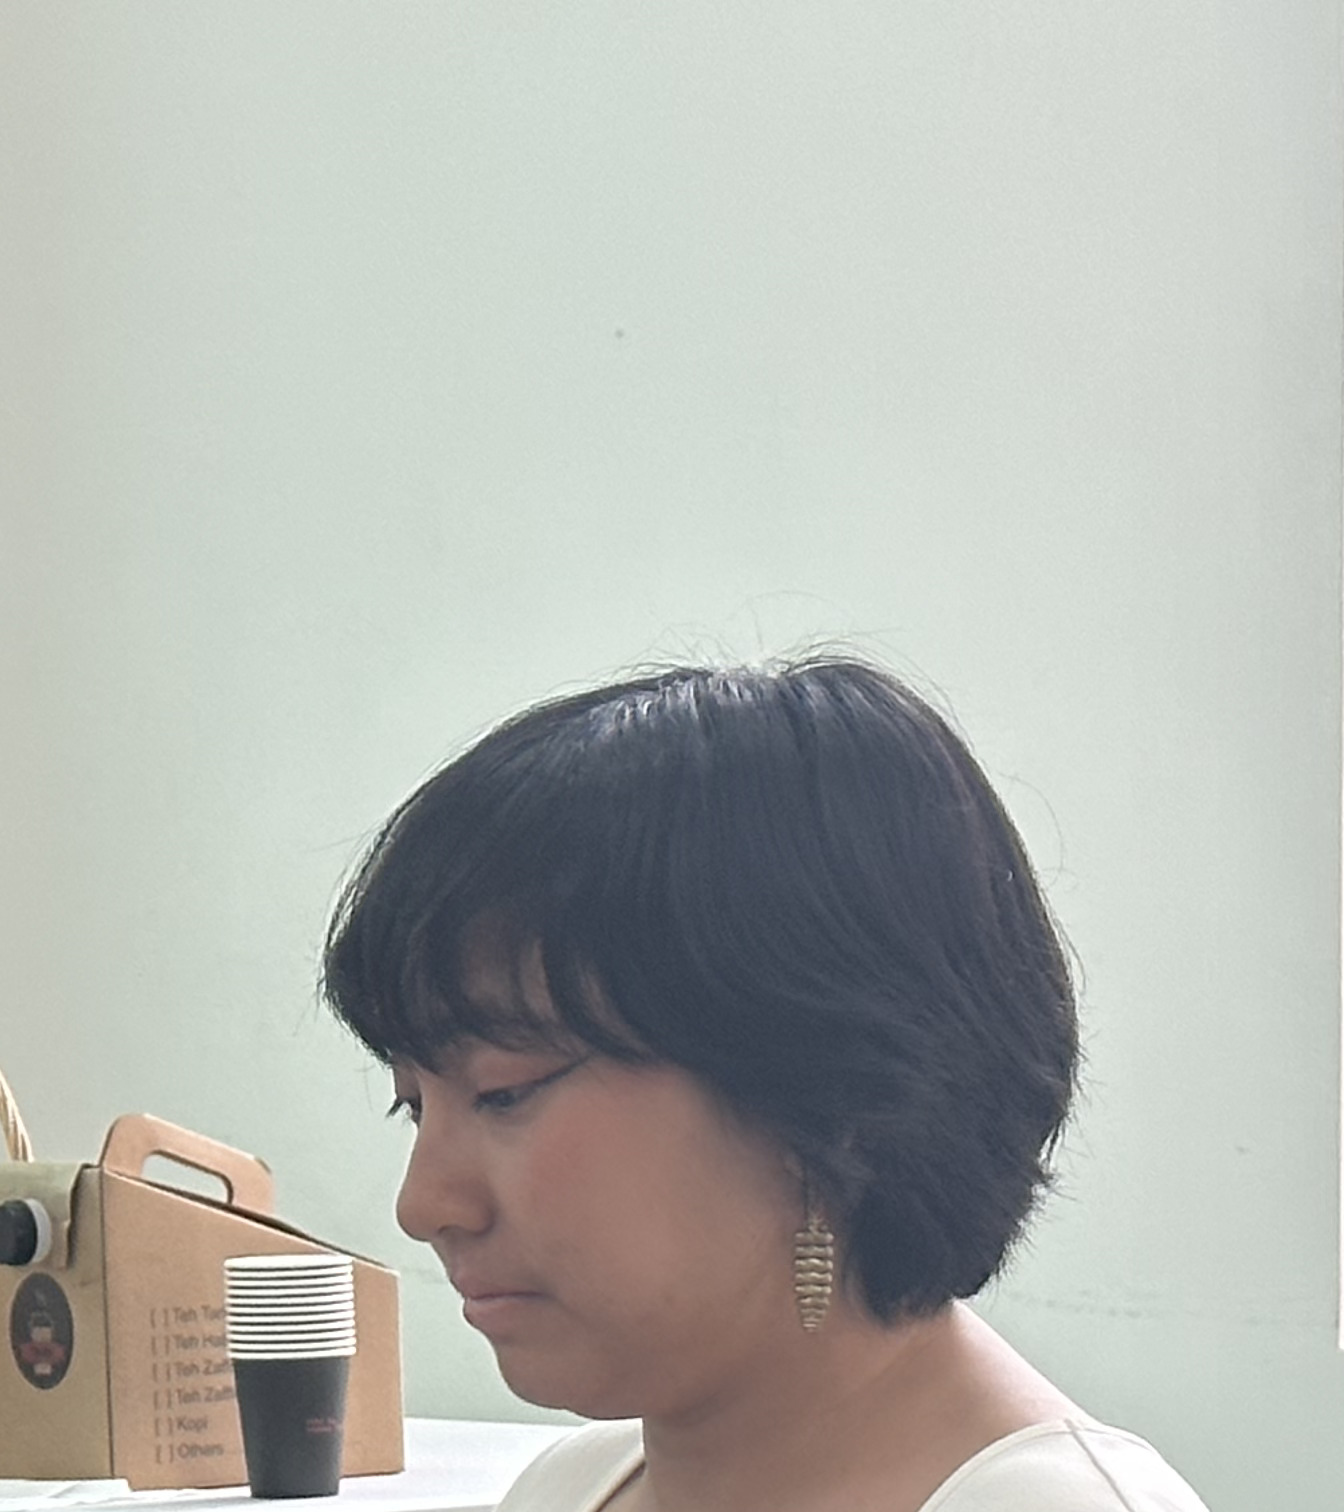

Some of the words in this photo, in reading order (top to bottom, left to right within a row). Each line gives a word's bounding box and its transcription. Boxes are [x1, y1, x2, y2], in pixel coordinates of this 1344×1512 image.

[173, 1306, 199, 1324] Teh
[173, 1335, 200, 1350] Teh
[175, 1361, 201, 1378] Teh
[176, 1388, 202, 1405] Teh
[177, 1415, 209, 1434] Kopi
[177, 1441, 225, 1459] Others
